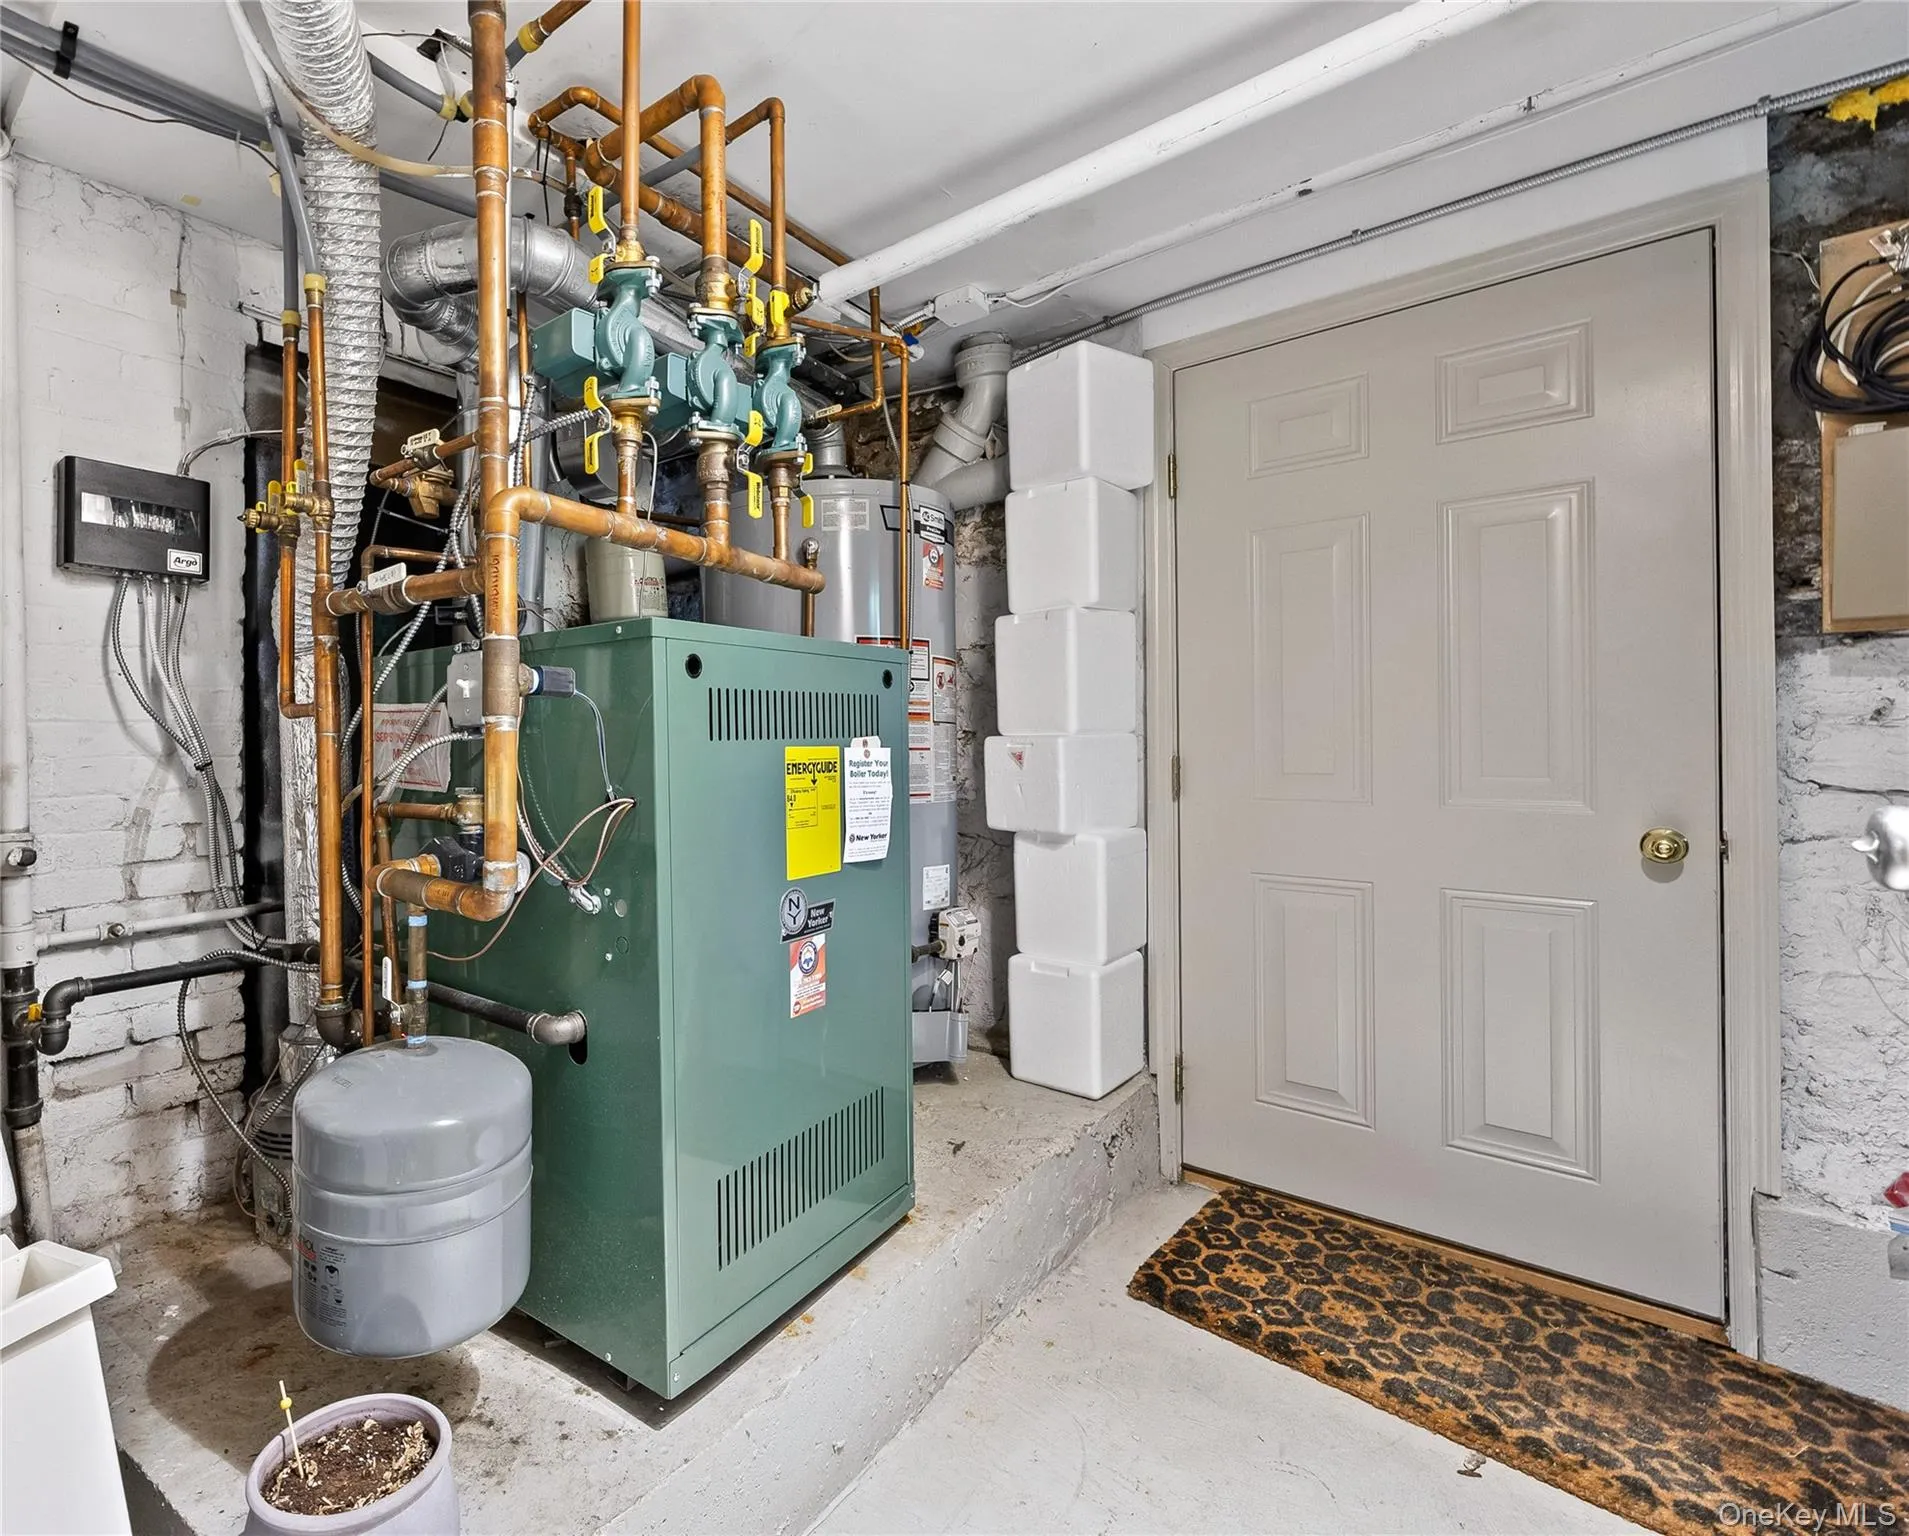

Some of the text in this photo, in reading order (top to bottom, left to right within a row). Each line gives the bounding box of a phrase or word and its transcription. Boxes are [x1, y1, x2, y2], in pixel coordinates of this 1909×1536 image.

[173, 556, 198, 567] Argo
[786, 761, 838, 775] ENERGYGUIDE
[848, 760, 873, 769] Register
[849, 770, 889, 778] Boiler Today!
[870, 832, 888, 840] Yorker
[810, 908, 825, 918] New
[807, 916, 829, 928] Yorker
